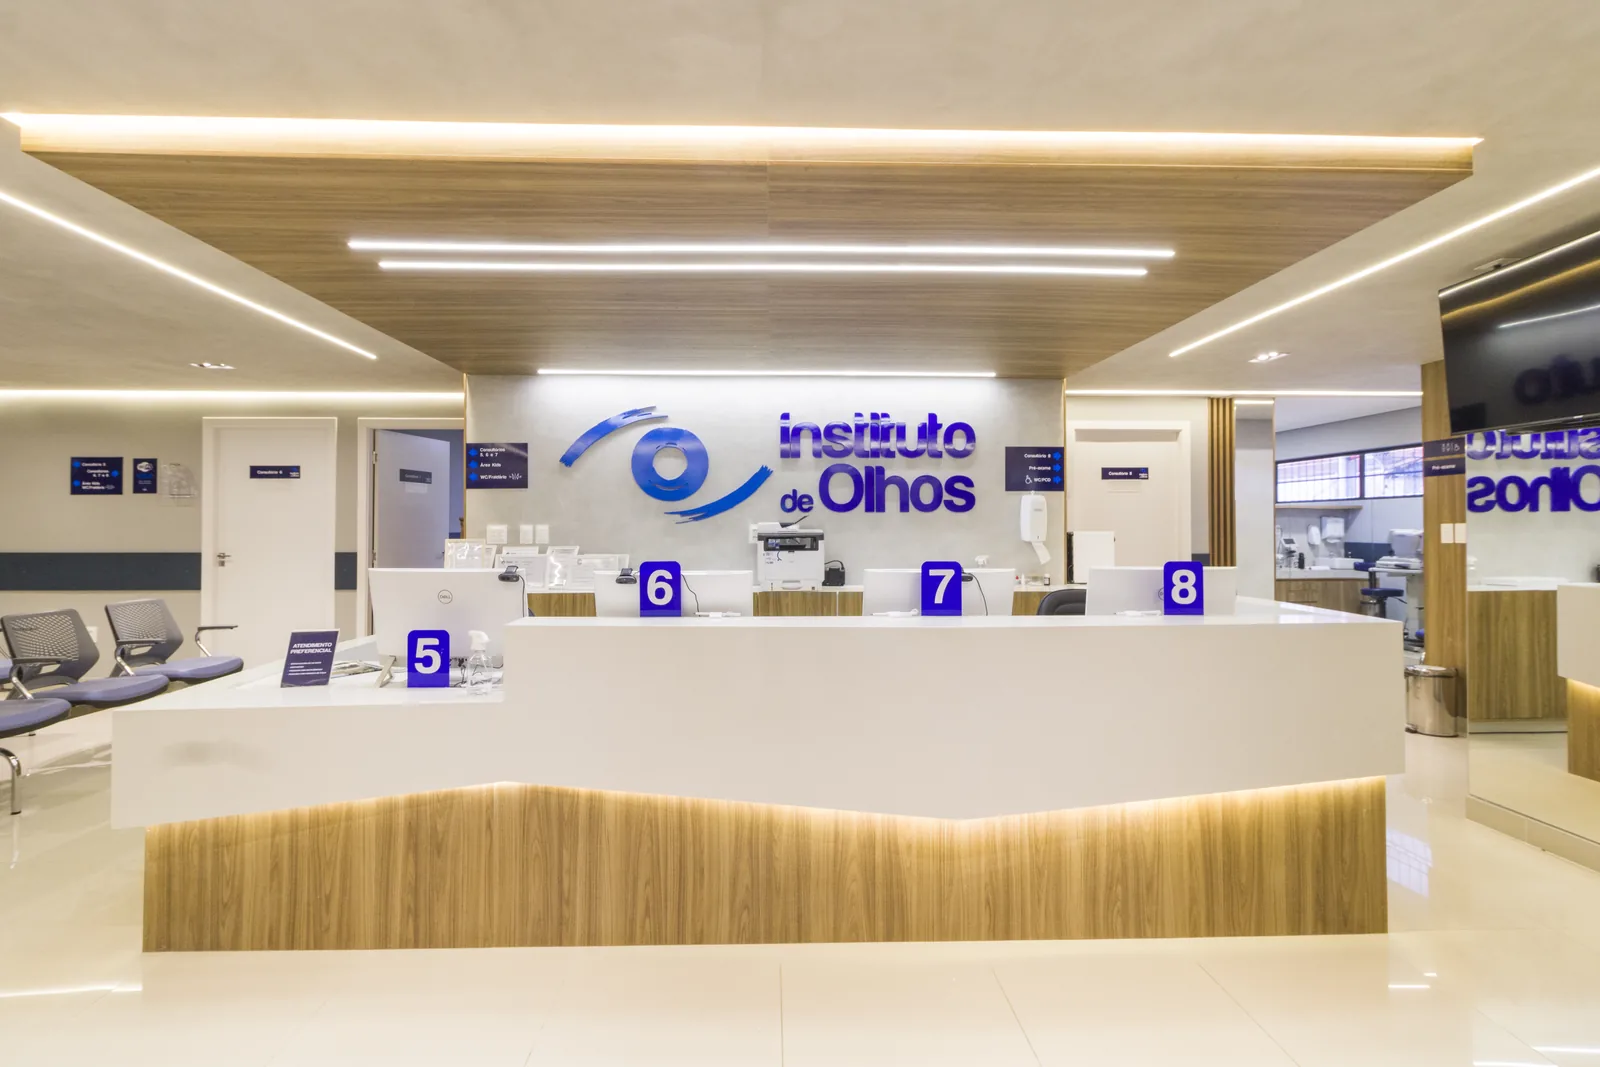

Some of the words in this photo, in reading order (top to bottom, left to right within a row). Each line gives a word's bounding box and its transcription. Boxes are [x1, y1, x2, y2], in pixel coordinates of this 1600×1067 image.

[780, 412, 976, 459] instituto
[780, 489, 814, 513] de
[818, 463, 976, 513] Olhos
[646, 569, 674, 606] 6
[928, 568, 956, 604] 7
[1170, 569, 1197, 604] 8
[414, 638, 442, 674] 5
